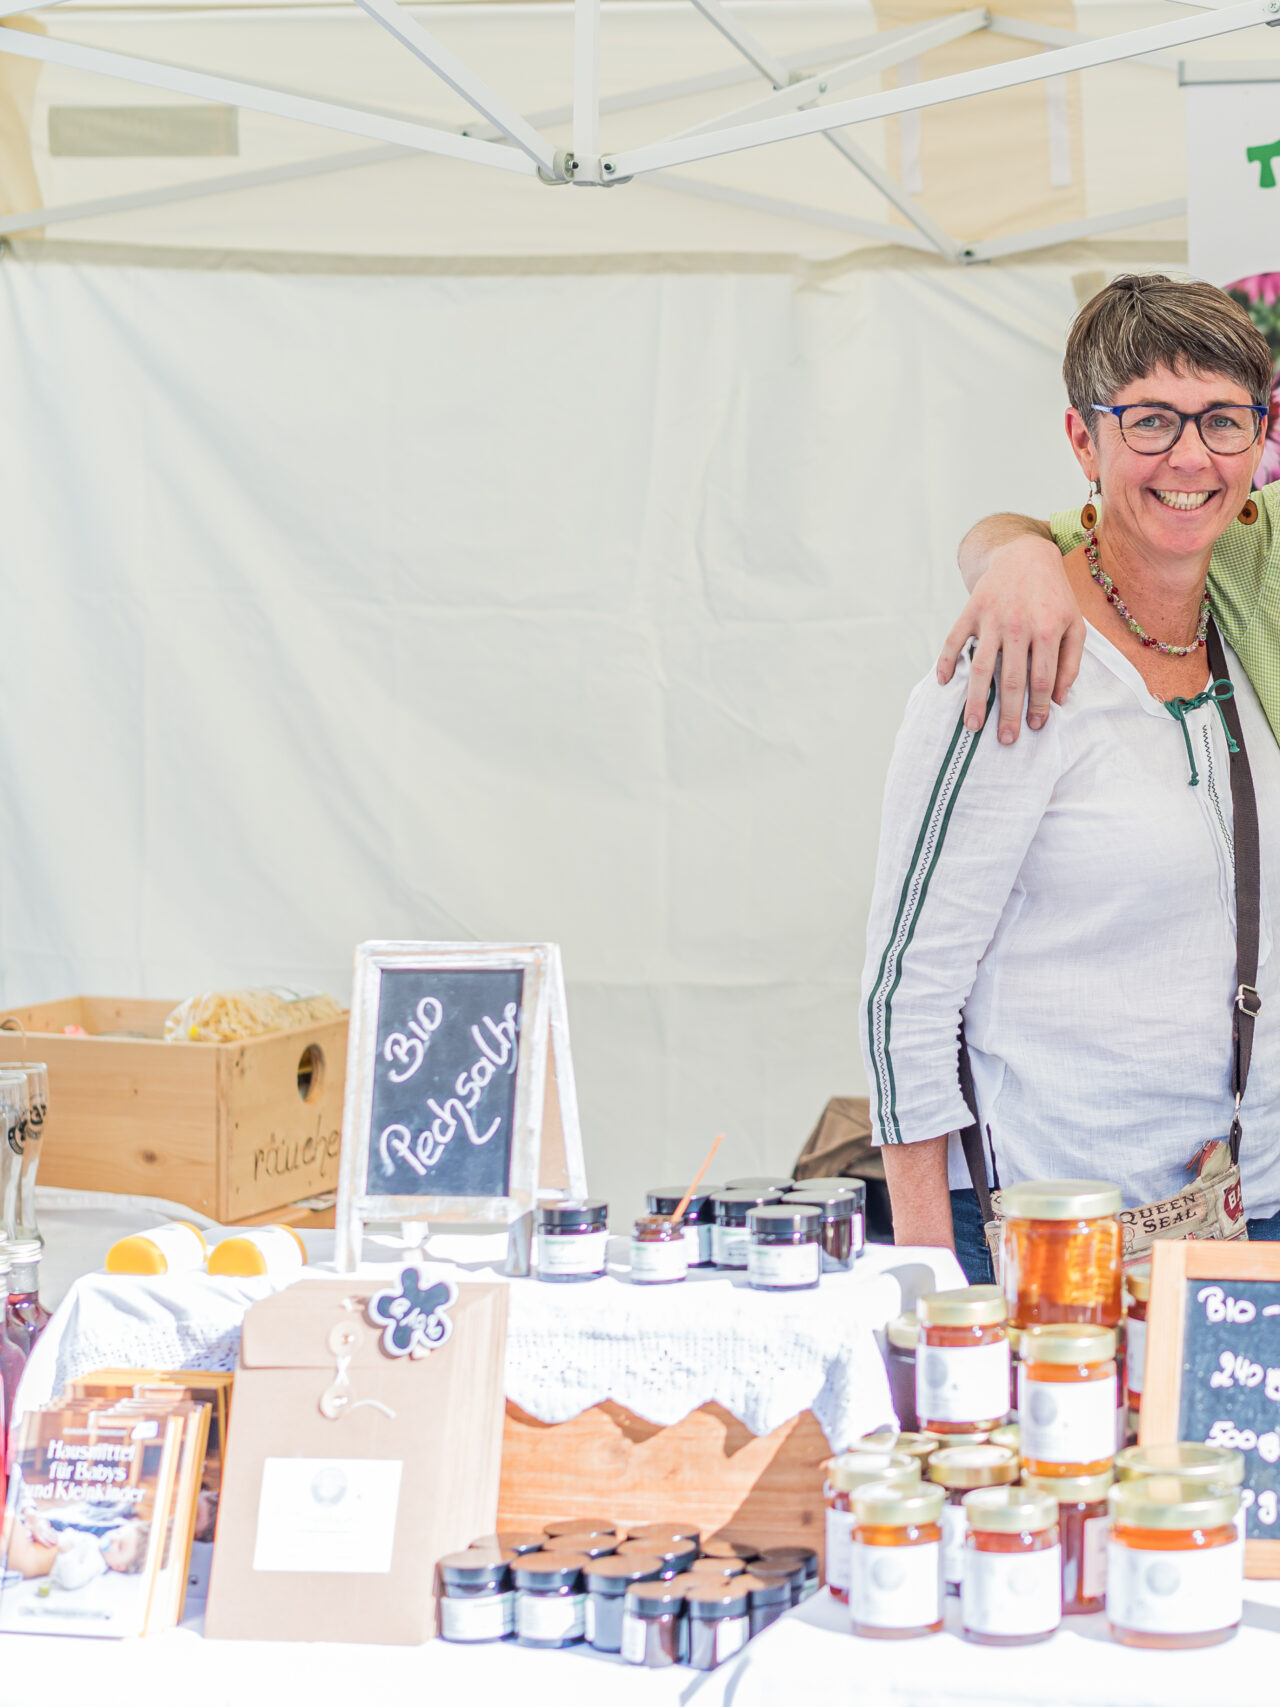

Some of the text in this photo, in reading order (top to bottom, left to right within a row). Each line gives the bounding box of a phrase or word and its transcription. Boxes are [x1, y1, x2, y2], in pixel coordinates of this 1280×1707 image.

[254, 1113, 339, 1182] räuche
[1119, 1192, 1196, 1225] QUEEN
[1143, 1208, 1197, 1234] SEAL
[49, 1460, 127, 1484] für Babys
